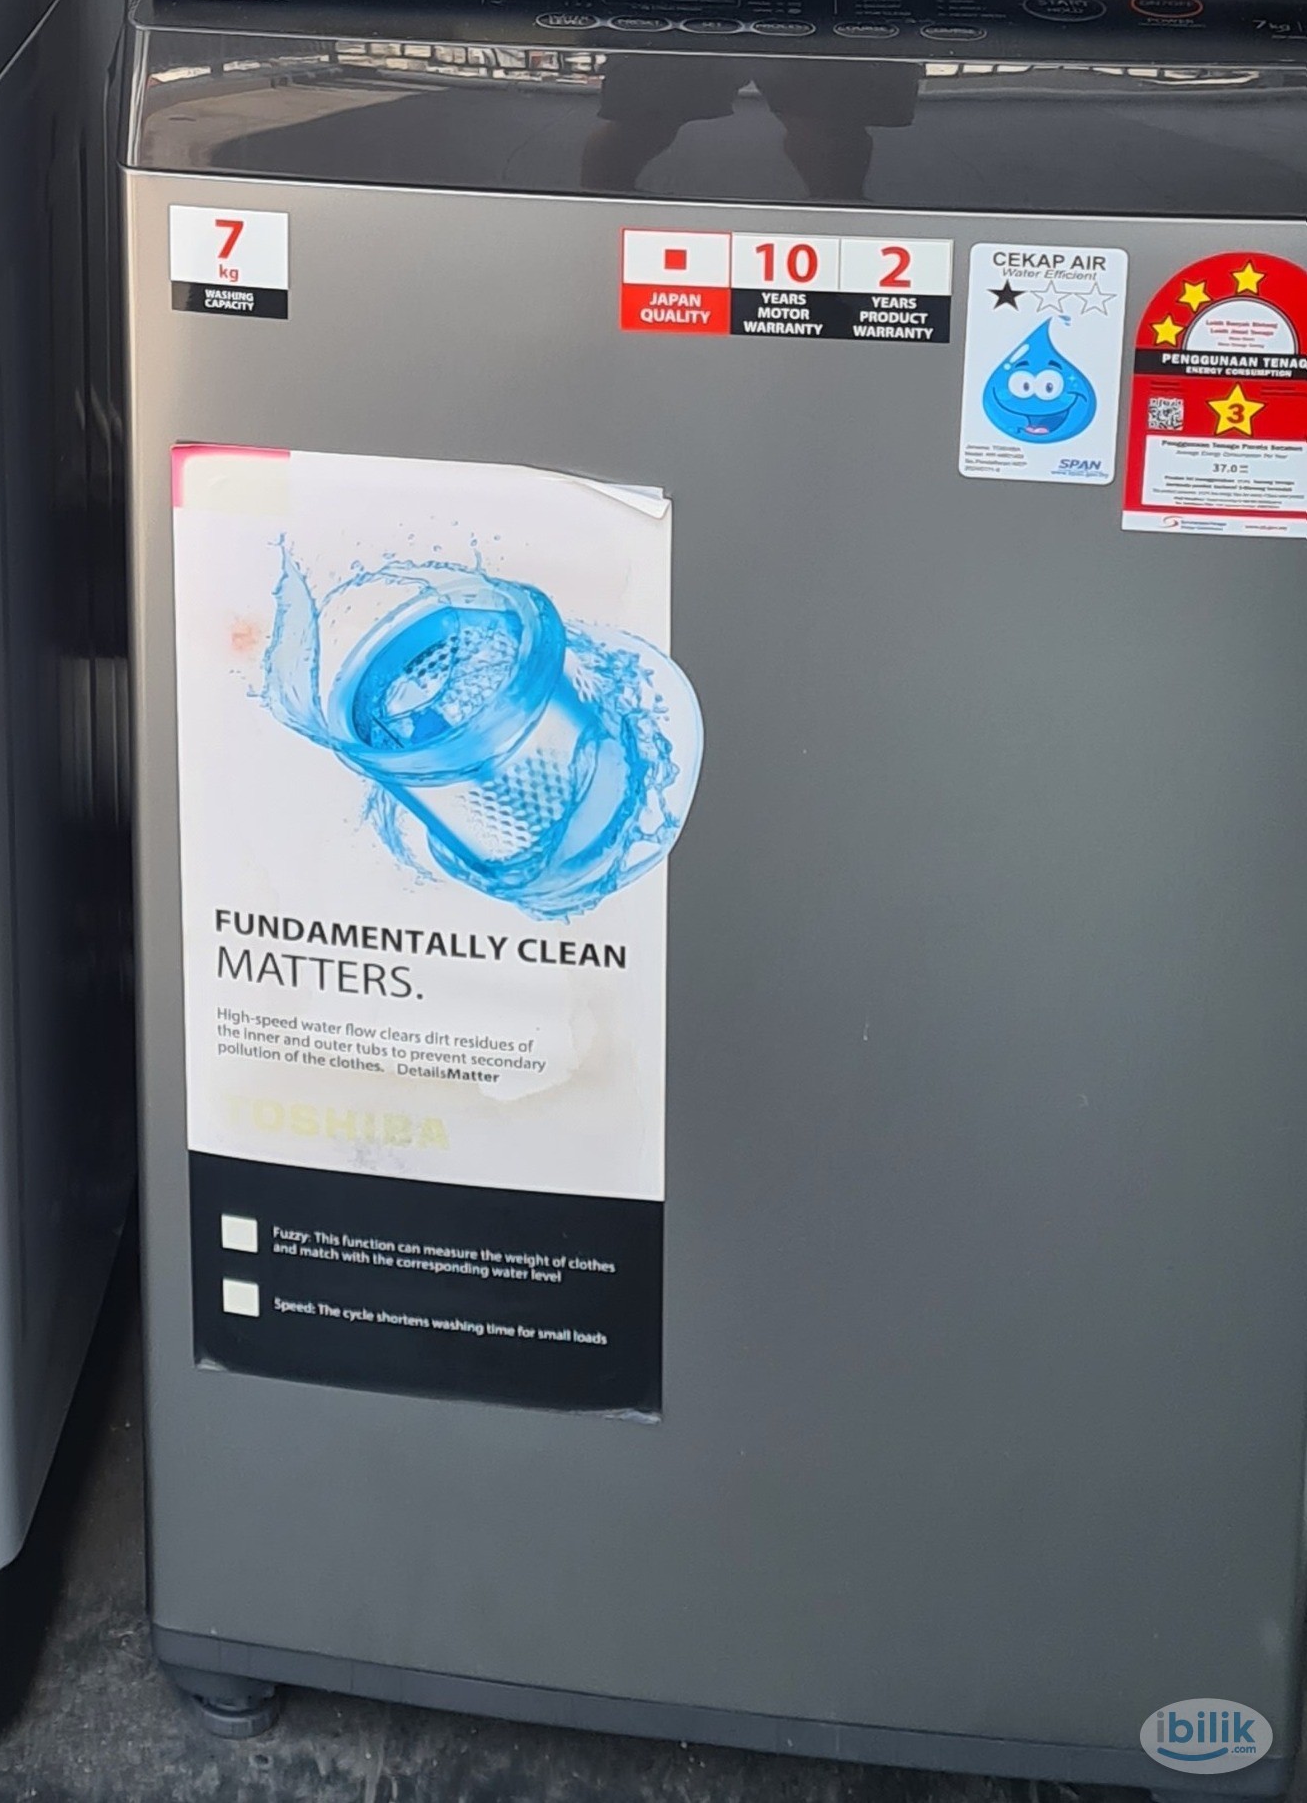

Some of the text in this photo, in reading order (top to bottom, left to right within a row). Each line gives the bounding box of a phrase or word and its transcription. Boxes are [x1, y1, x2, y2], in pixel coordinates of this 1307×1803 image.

[215, 219, 244, 282] 7 kg
[755, 242, 818, 283] 10
[879, 246, 912, 288] 2
[992, 251, 1107, 271] CEKAP AIR
[1002, 268, 1097, 281] Water Efficient
[204, 289, 254, 302] WASHING
[649, 292, 702, 308] JAPAN
[761, 292, 807, 306] YEARS
[871, 296, 917, 310] YEARS
[204, 299, 255, 311] CAPACITY
[757, 307, 810, 321] MOTOR
[640, 308, 711, 325] QUALITY
[859, 311, 928, 325] PRODUCT
[743, 320, 824, 336] WARRANTY
[853, 324, 934, 340] WARRANTY
[1162, 353, 1307, 370] PENGGUNAAN TENAG
[1186, 366, 1292, 377] ENERGY CONSUMPTION
[1226, 403, 1245, 423] 3
[1058, 458, 1102, 471] SPAN
[215, 909, 627, 969] FUNDAMENTALLY CLEAN
[216, 946, 424, 1000] MATTERS.
[217, 1007, 534, 1053] High-speed water flow clears dirt residues of
[217, 1025, 546, 1073] the inner and outer tubs to prevent secondary
[218, 1043, 500, 1083] pollution of the clothes. DetailsMatter
[222, 1096, 450, 1151] TOSHIBA
[273, 1225, 616, 1273] Fuzzy: This function can measure the weight of clothes
[273, 1242, 562, 1283] and match with the corresponding water level
[274, 1296, 608, 1345] Speed: The cycle shortens washing time for small loads
